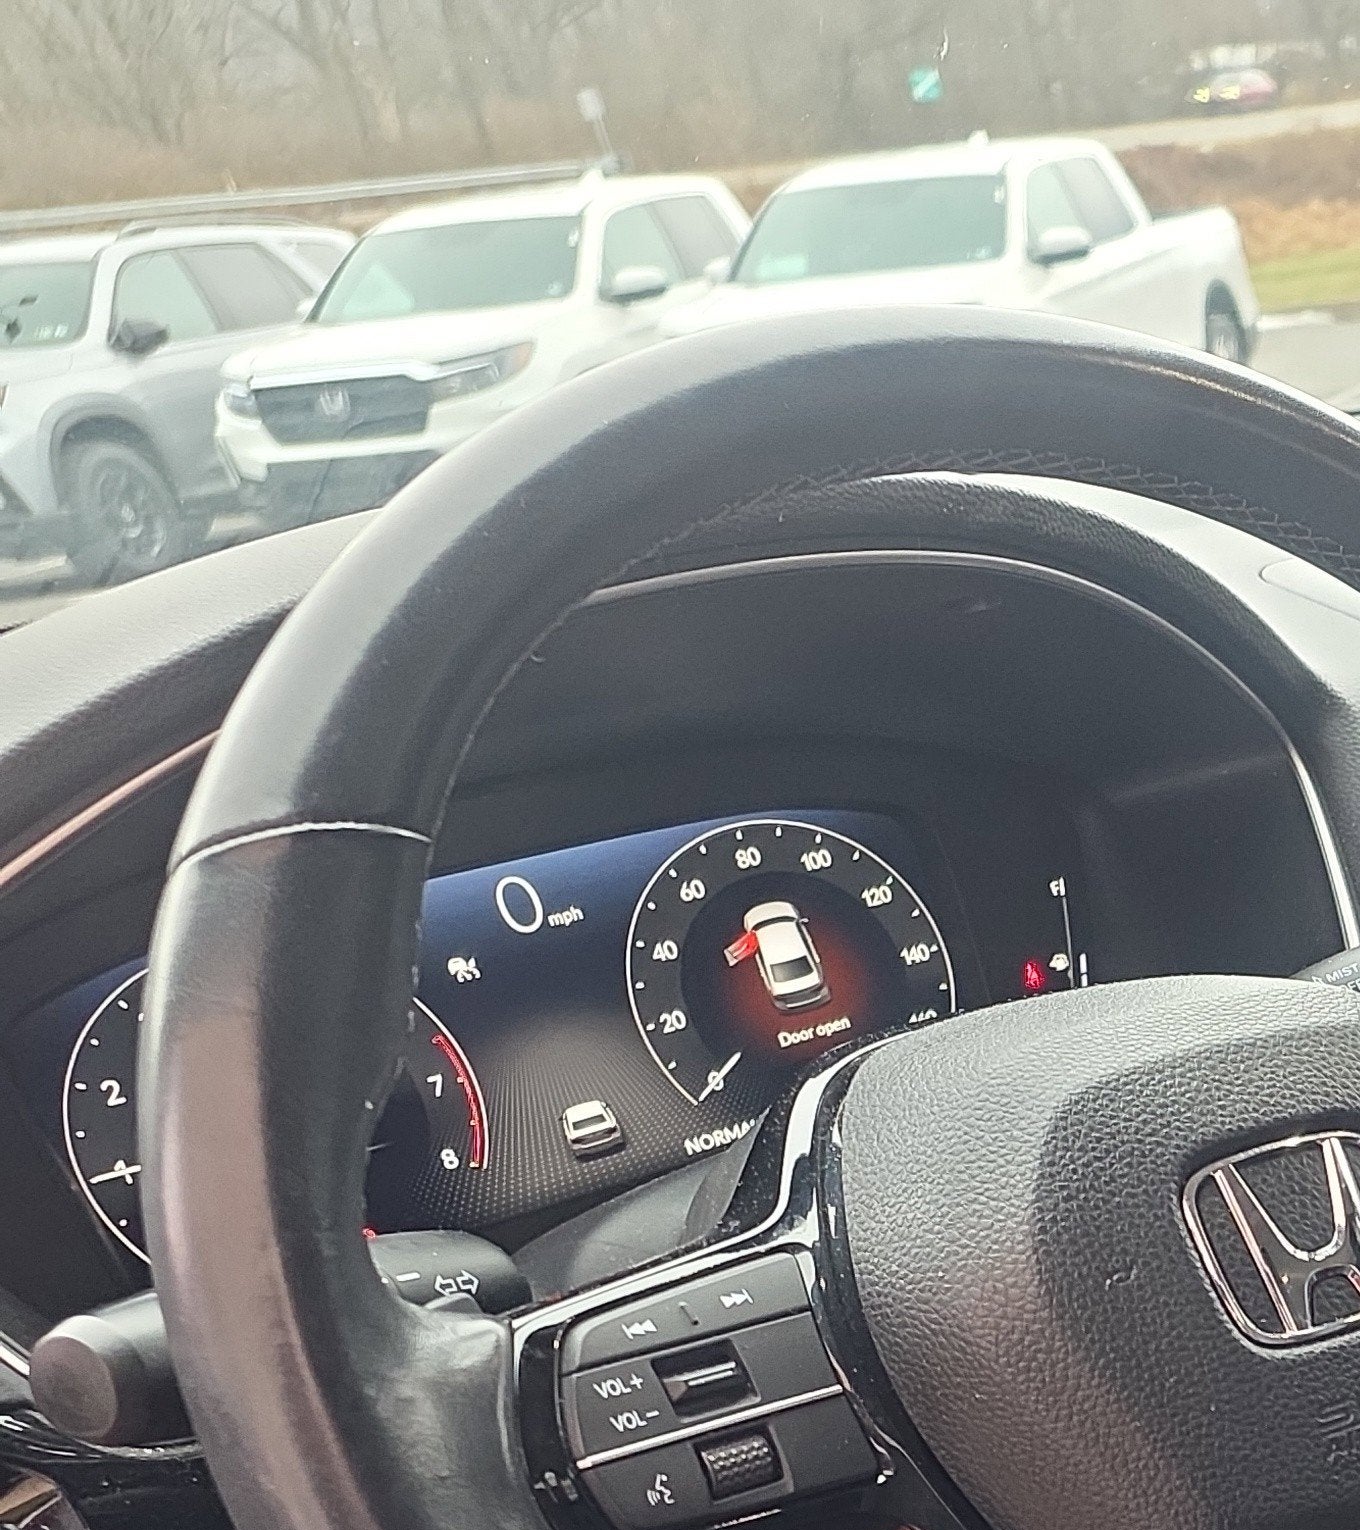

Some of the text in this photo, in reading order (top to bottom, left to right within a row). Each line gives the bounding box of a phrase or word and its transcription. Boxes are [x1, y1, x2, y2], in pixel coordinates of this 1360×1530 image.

[735, 846, 762, 870] 80
[800, 849, 833, 872] 100
[679, 878, 706, 902] 60
[861, 884, 893, 908] 120
[496, 876, 543, 933] 0
[547, 904, 585, 927] mph
[652, 939, 678, 962] 40
[900, 944, 930, 966] 140
[1325, 962, 1359, 983] MIST
[659, 1009, 687, 1034] 20
[777, 1016, 851, 1049] Door open
[100, 1079, 127, 1107] 2
[426, 1073, 443, 1098] 7
[684, 1118, 756, 1156] NORMA
[440, 1148, 460, 1170] 8
[593, 1374, 645, 1399] VOL+
[609, 1408, 660, 1433] VOL-
